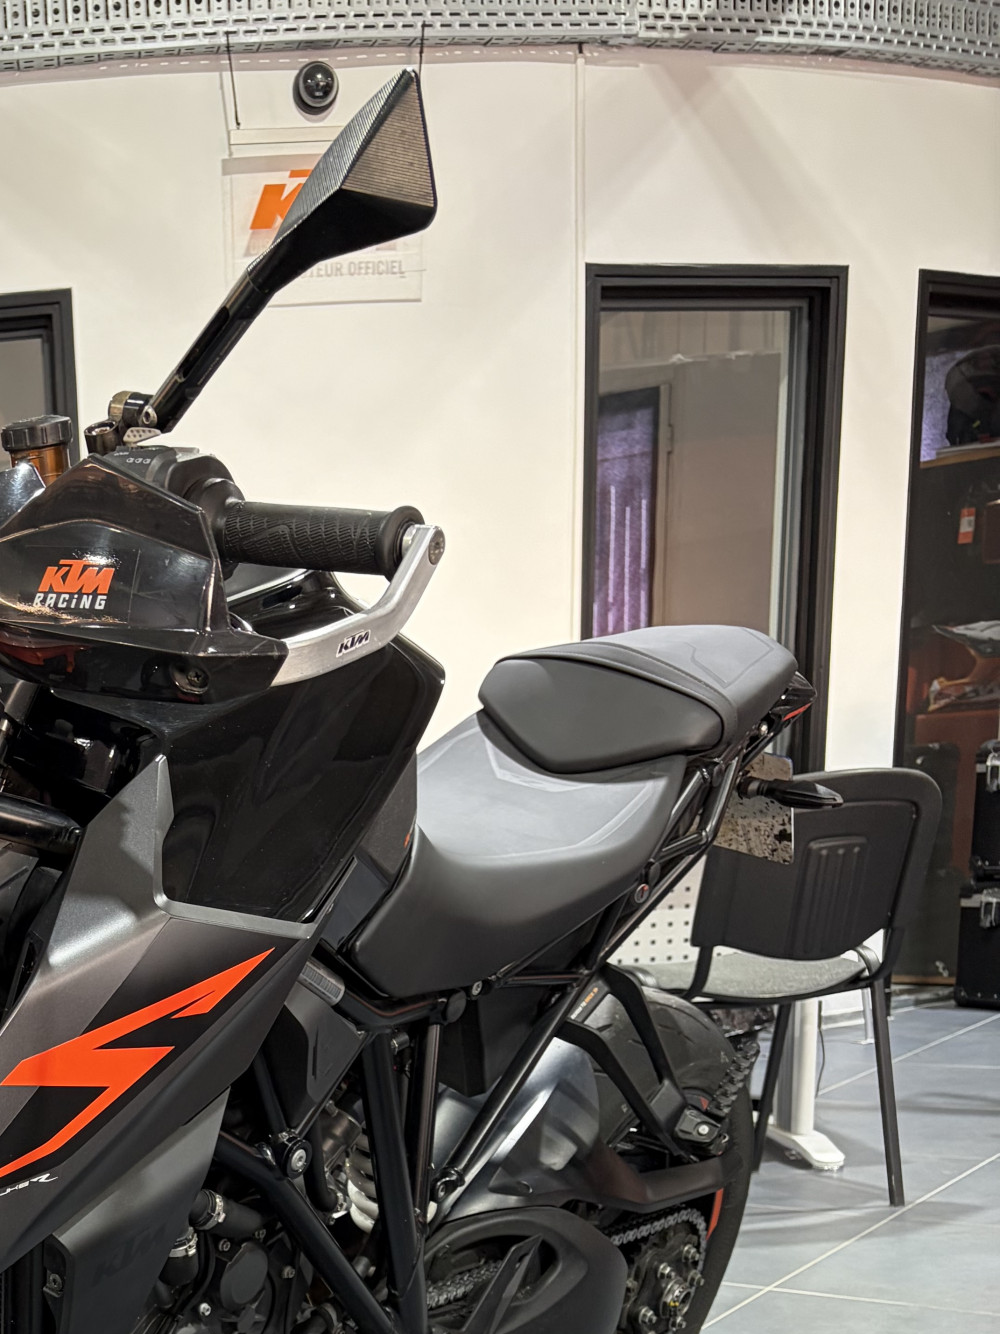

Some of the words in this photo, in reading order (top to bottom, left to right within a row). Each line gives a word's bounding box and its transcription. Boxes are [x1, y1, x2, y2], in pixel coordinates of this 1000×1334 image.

[347, 259, 406, 277] OFFICIEL
[38, 560, 115, 594] KTM
[337, 630, 371, 657] KTM
